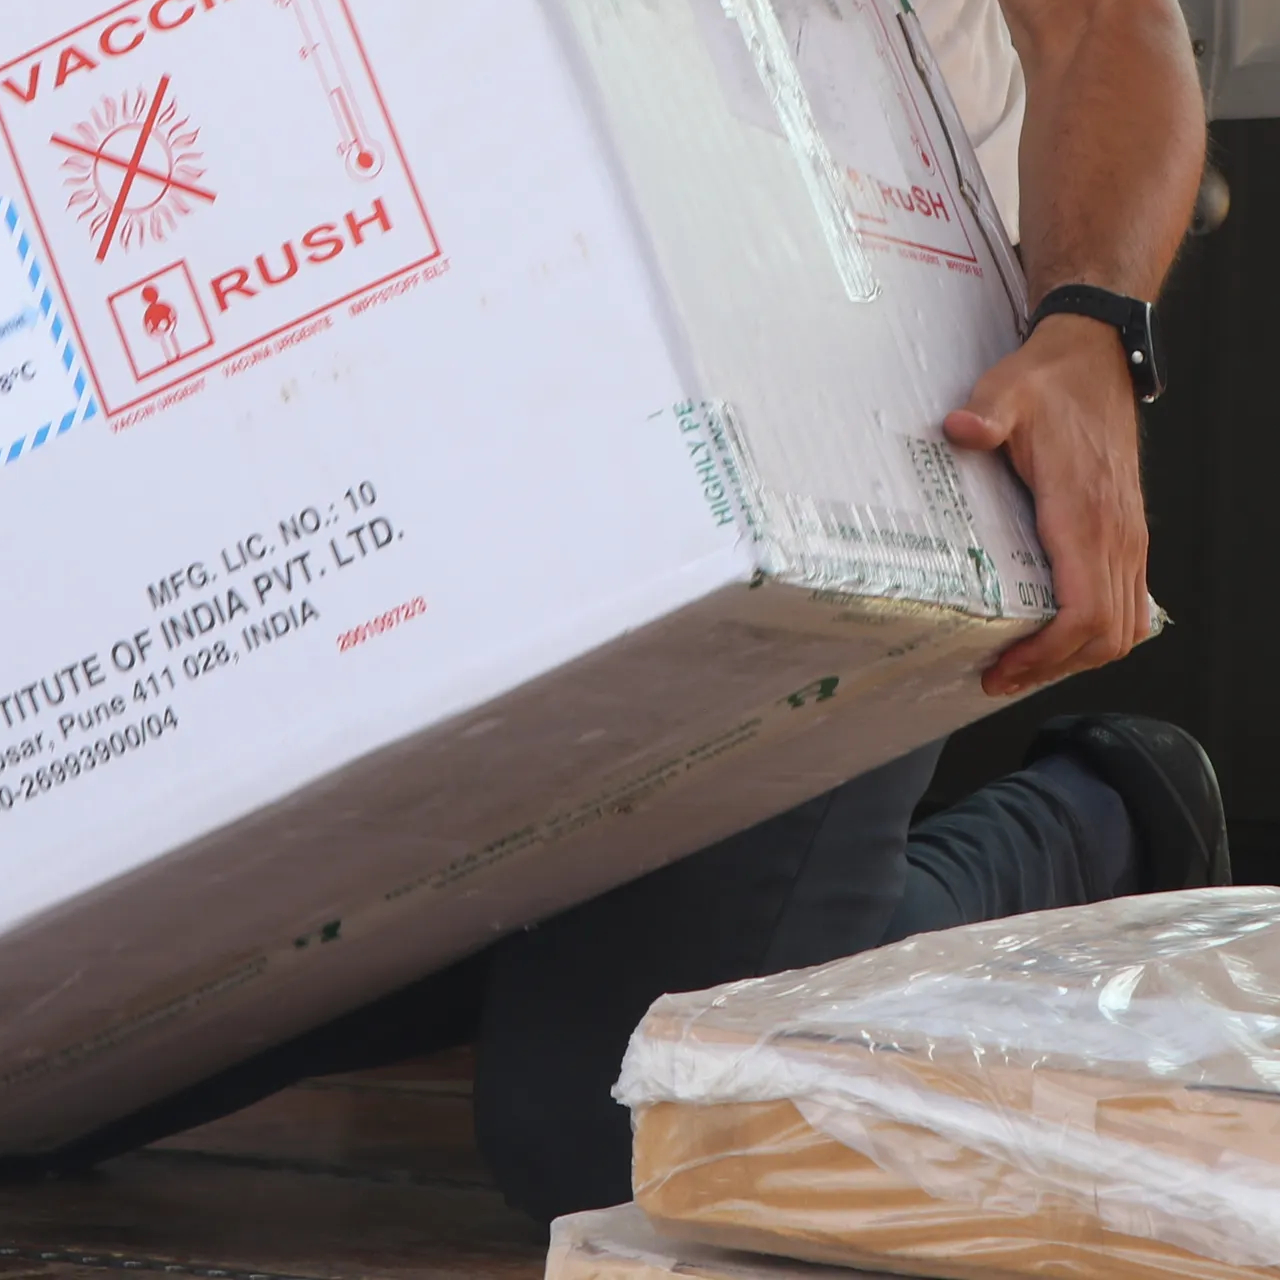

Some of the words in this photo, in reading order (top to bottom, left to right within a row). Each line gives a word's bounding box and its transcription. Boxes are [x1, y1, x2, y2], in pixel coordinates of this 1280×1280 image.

[209, 196, 393, 314] RUSH
[876, 184, 951, 222] RUSH
[147, 562, 217, 610] MFG.
[220, 532, 275, 576] LIC.
[344, 480, 378, 513] 10
[686, 439, 734, 527] HIGHLY
[111, 628, 153, 672] OF
[160, 587, 249, 651] INDIA
[252, 551, 326, 606] PVT.
[329, 516, 405, 569] LTD.
[58, 696, 126, 742] Pune
[133, 665, 176, 704] 411
[241, 598, 320, 653] INDIA
